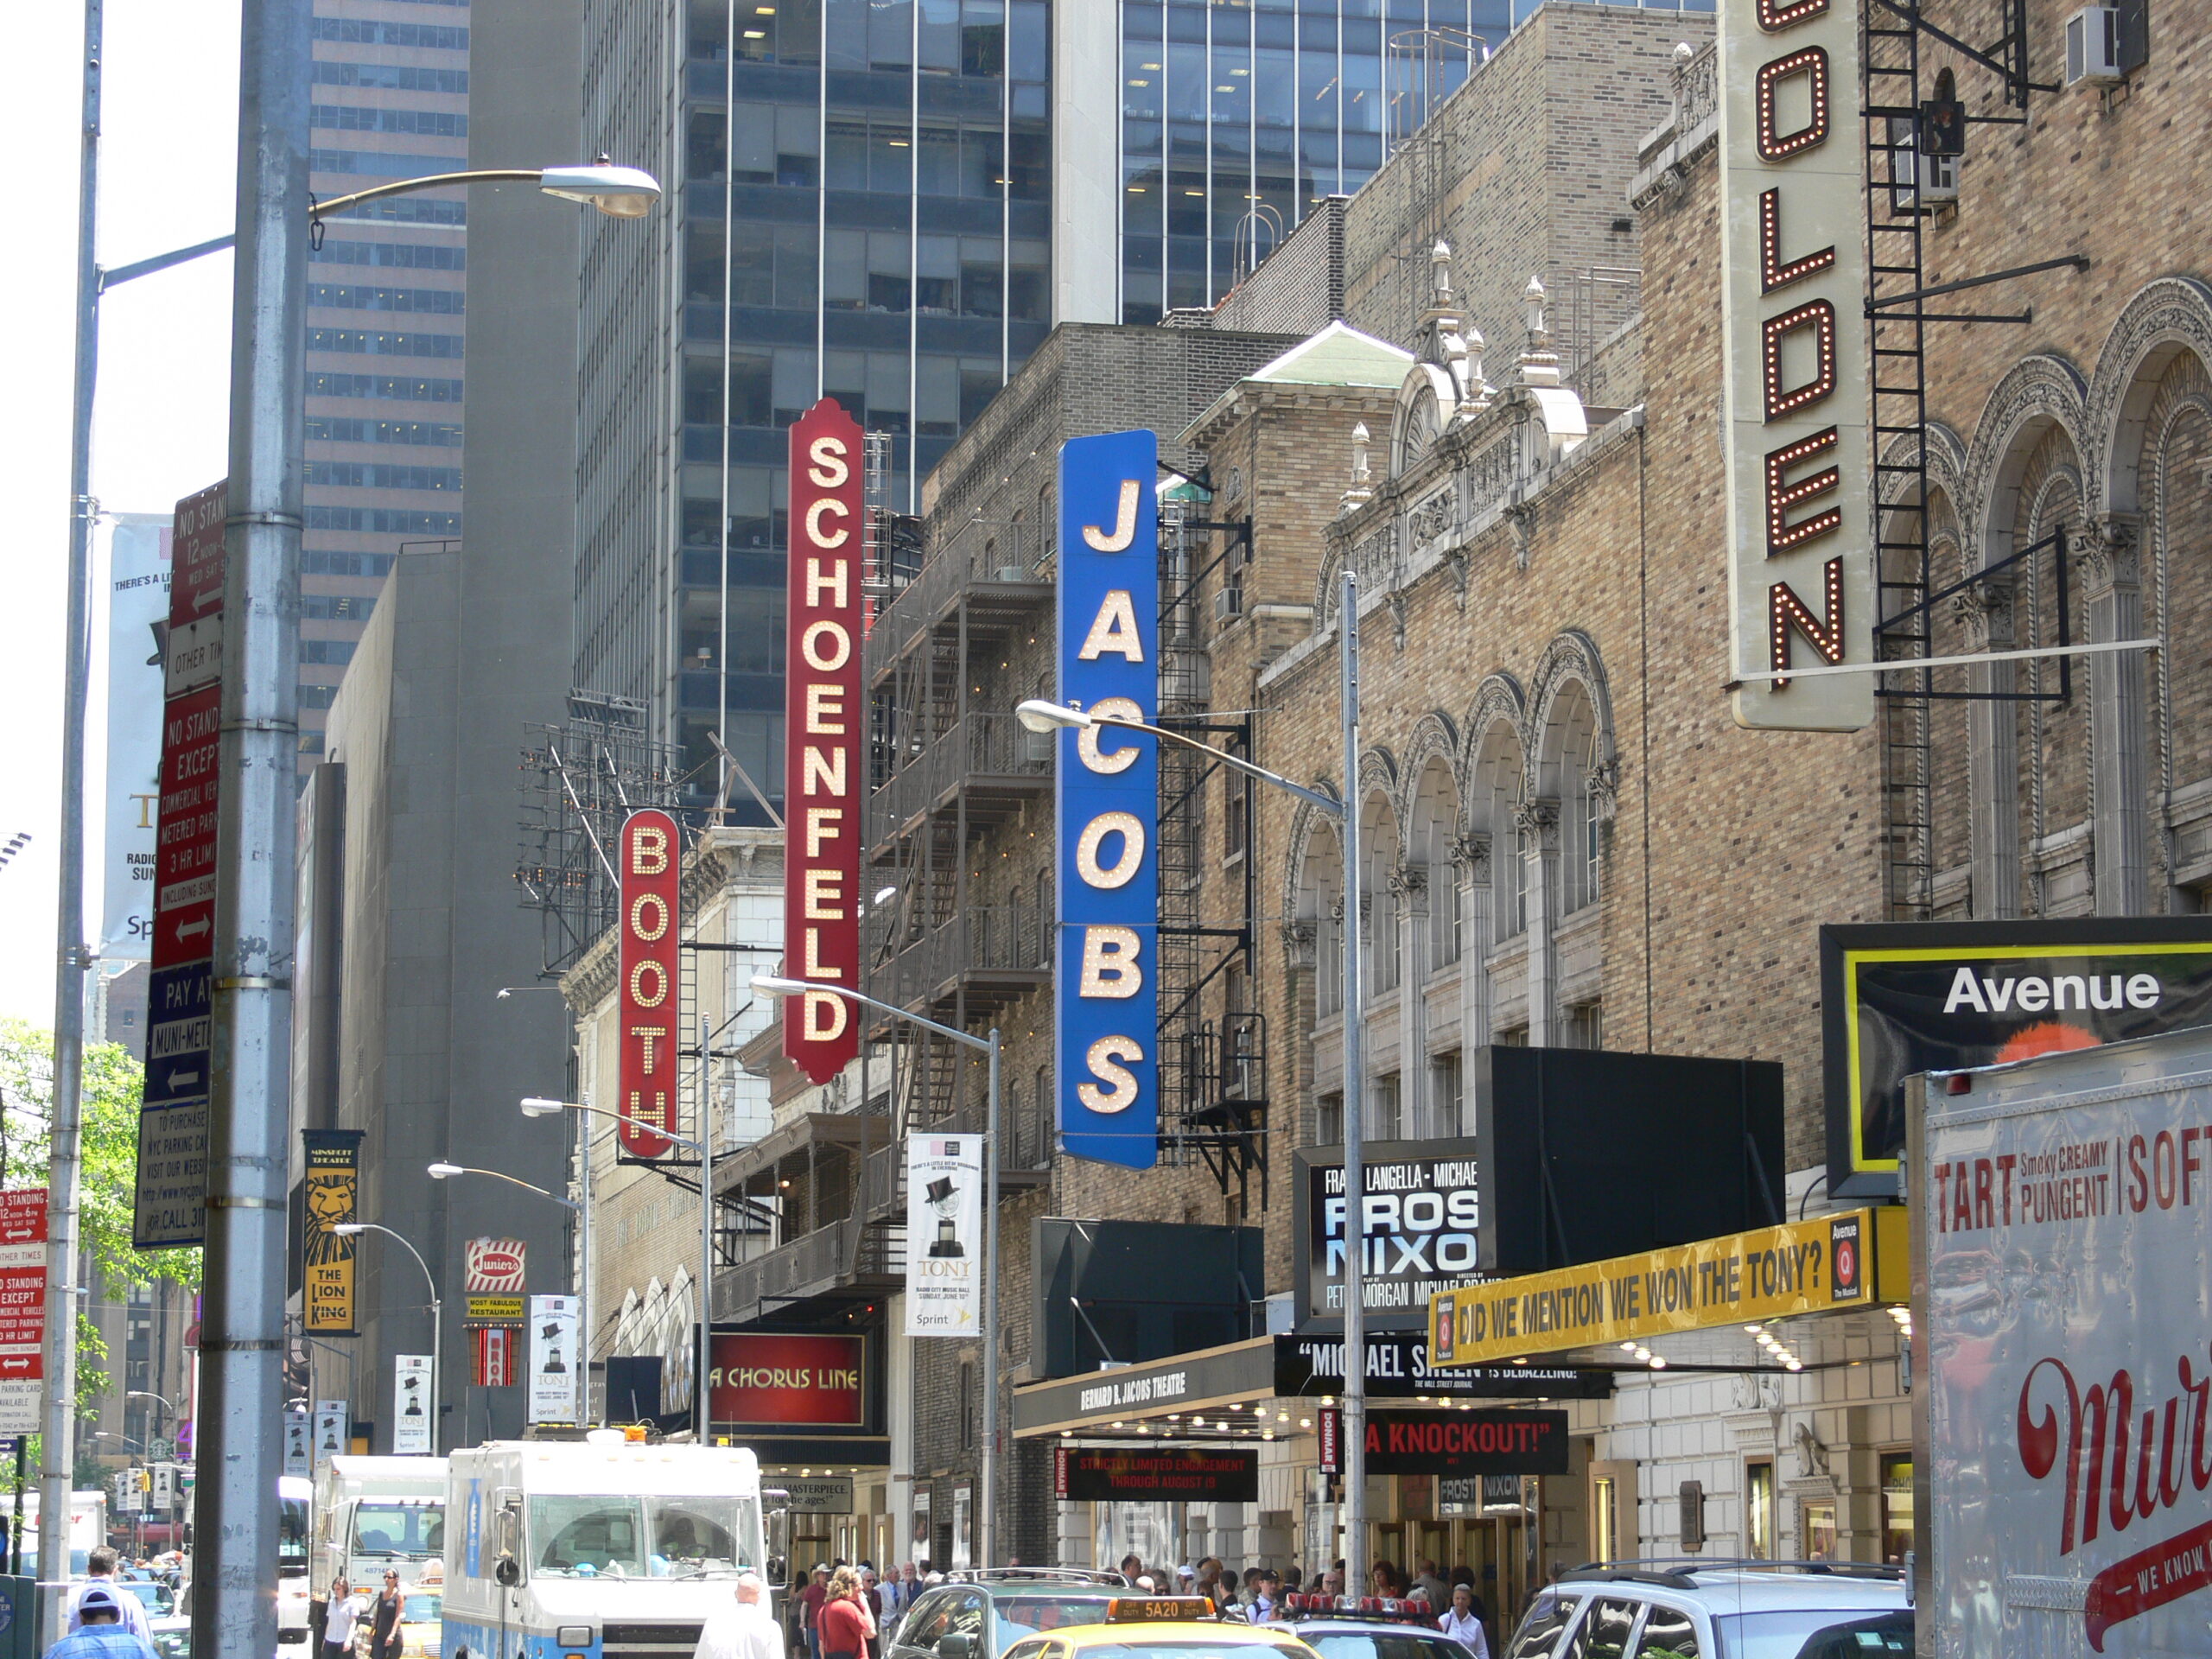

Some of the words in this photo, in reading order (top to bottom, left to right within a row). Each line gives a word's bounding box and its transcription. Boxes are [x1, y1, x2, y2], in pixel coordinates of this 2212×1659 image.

[1755, 0, 1843, 692] OLDEN
[180, 510, 194, 539] NO
[200, 493, 227, 531] STAN
[188, 538, 200, 566] 12
[115, 573, 151, 592] THERE'S
[153, 574, 160, 583] A
[176, 646, 205, 674] OTHER
[168, 720, 182, 747] NO
[802, 437, 850, 1042] SCHOENFELD
[162, 785, 201, 816] COMMERCIAL
[1076, 480, 1146, 1115] JACOBS
[162, 817, 195, 845] METERED
[170, 853, 177, 874] 3
[180, 849, 193, 871] HR
[196, 841, 216, 866] LIMI
[163, 885, 197, 906] INCLUDING
[166, 978, 192, 1010] PAY
[630, 826, 669, 1140] BOOTH
[1943, 966, 2160, 1014] Avenue
[159, 1116, 168, 1133] TO
[169, 1111, 206, 1131] PURCHASE
[148, 1140, 162, 1158] NYC
[164, 1135, 193, 1155] PARKING
[146, 1161, 164, 1180] VISIT
[167, 1160, 181, 1178] OUR
[1366, 1164, 1422, 1192] LANGELLA
[1934, 1154, 2017, 1234] TART
[2021, 1149, 2056, 1178] Smoky
[2058, 1141, 2108, 1169] CREAMY
[2021, 1173, 2108, 1224] PUNGENT
[8, 1192, 45, 1206] STANDING
[162, 1209, 187, 1229] CALL
[1832, 1224, 1858, 1241] Avenue
[0, 1252, 18, 1261] THER
[22, 1250, 41, 1261] TIMES
[475, 1252, 519, 1272] Junior's
[1840, 1250, 1851, 1275] Q
[317, 1269, 341, 1281] THE
[917, 1261, 973, 1277] TONY
[7, 1277, 44, 1290] STANDING
[312, 1283, 346, 1303] LION
[1842, 1286, 1858, 1297] Musical
[2, 1292, 35, 1305] EXCEPT
[1326, 1286, 1345, 1308] PET
[1459, 1303, 1486, 1345] DID
[1491, 1296, 1517, 1340] WE
[1522, 1281, 1604, 1335] MENTION
[1610, 1274, 1640, 1322] WE
[1644, 1264, 1692, 1315] WON
[1699, 1255, 1740, 1307] THE
[22, 1306, 45, 1315] VEHICLES
[311, 1305, 347, 1325] KING
[917, 1313, 949, 1327] Sprint
[19, 1319, 44, 1328] PARKING
[6, 1331, 16, 1341] HR
[17, 1330, 35, 1340] LIMIT
[1299, 1343, 1405, 1377] “MICAEL
[26, 1382, 41, 1394] CARD
[537, 1375, 572, 1386] TONY
[709, 1367, 723, 1389] A
[728, 1367, 810, 1389] CHORUS
[818, 1369, 858, 1390] LINE
[1081, 1385, 1113, 1411] BERNARD
[1114, 1384, 1122, 1405] B.
[1122, 1378, 1151, 1404] JACOBS
[1153, 1371, 1186, 1399] THEATRE
[1323, 1412, 1332, 1463] DONMAR
[1364, 1423, 1381, 1453] A
[1080, 1458, 1128, 1470] STRICTLY
[1131, 1458, 1173, 1471] LIMITED
[1175, 1458, 1245, 1471] ENGAGEMENT
[785, 1484, 849, 1495] MASTERPIECE.
[1109, 1475, 1159, 1488] THROUGH
[1161, 1476, 1203, 1489] AUGUST
[1441, 1478, 1476, 1501] FROST
[772, 1493, 786, 1504] for
[2137, 1565, 2159, 1595] WE
[2164, 1544, 2205, 1585] KNOW
[1146, 1601, 1179, 1618] 5A20
